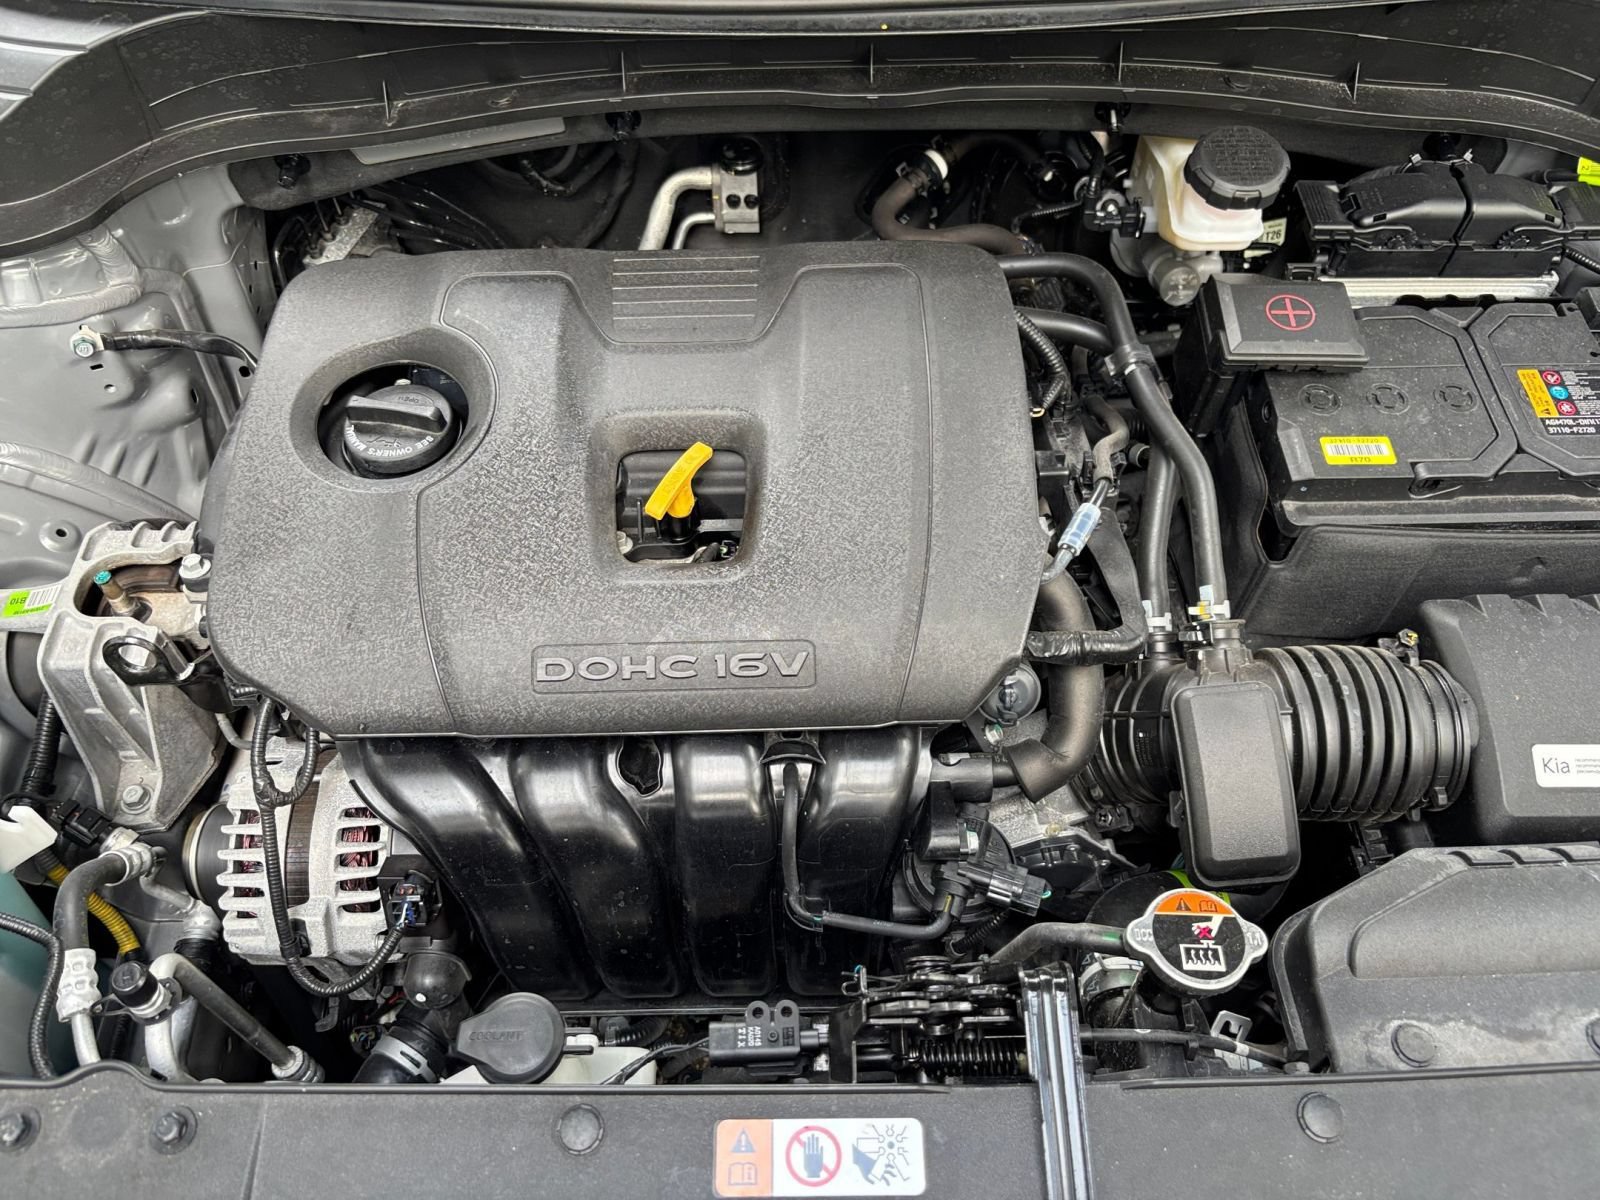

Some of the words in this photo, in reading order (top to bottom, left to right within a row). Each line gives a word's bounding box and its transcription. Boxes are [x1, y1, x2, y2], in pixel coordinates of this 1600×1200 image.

[345, 424, 368, 451] MANUAL
[414, 435, 435, 450] SEE
[367, 446, 413, 457] OWNER'S
[536, 654, 699, 682] DOHC
[714, 651, 810, 678] 16V
[1542, 757, 1570, 774] Kia
